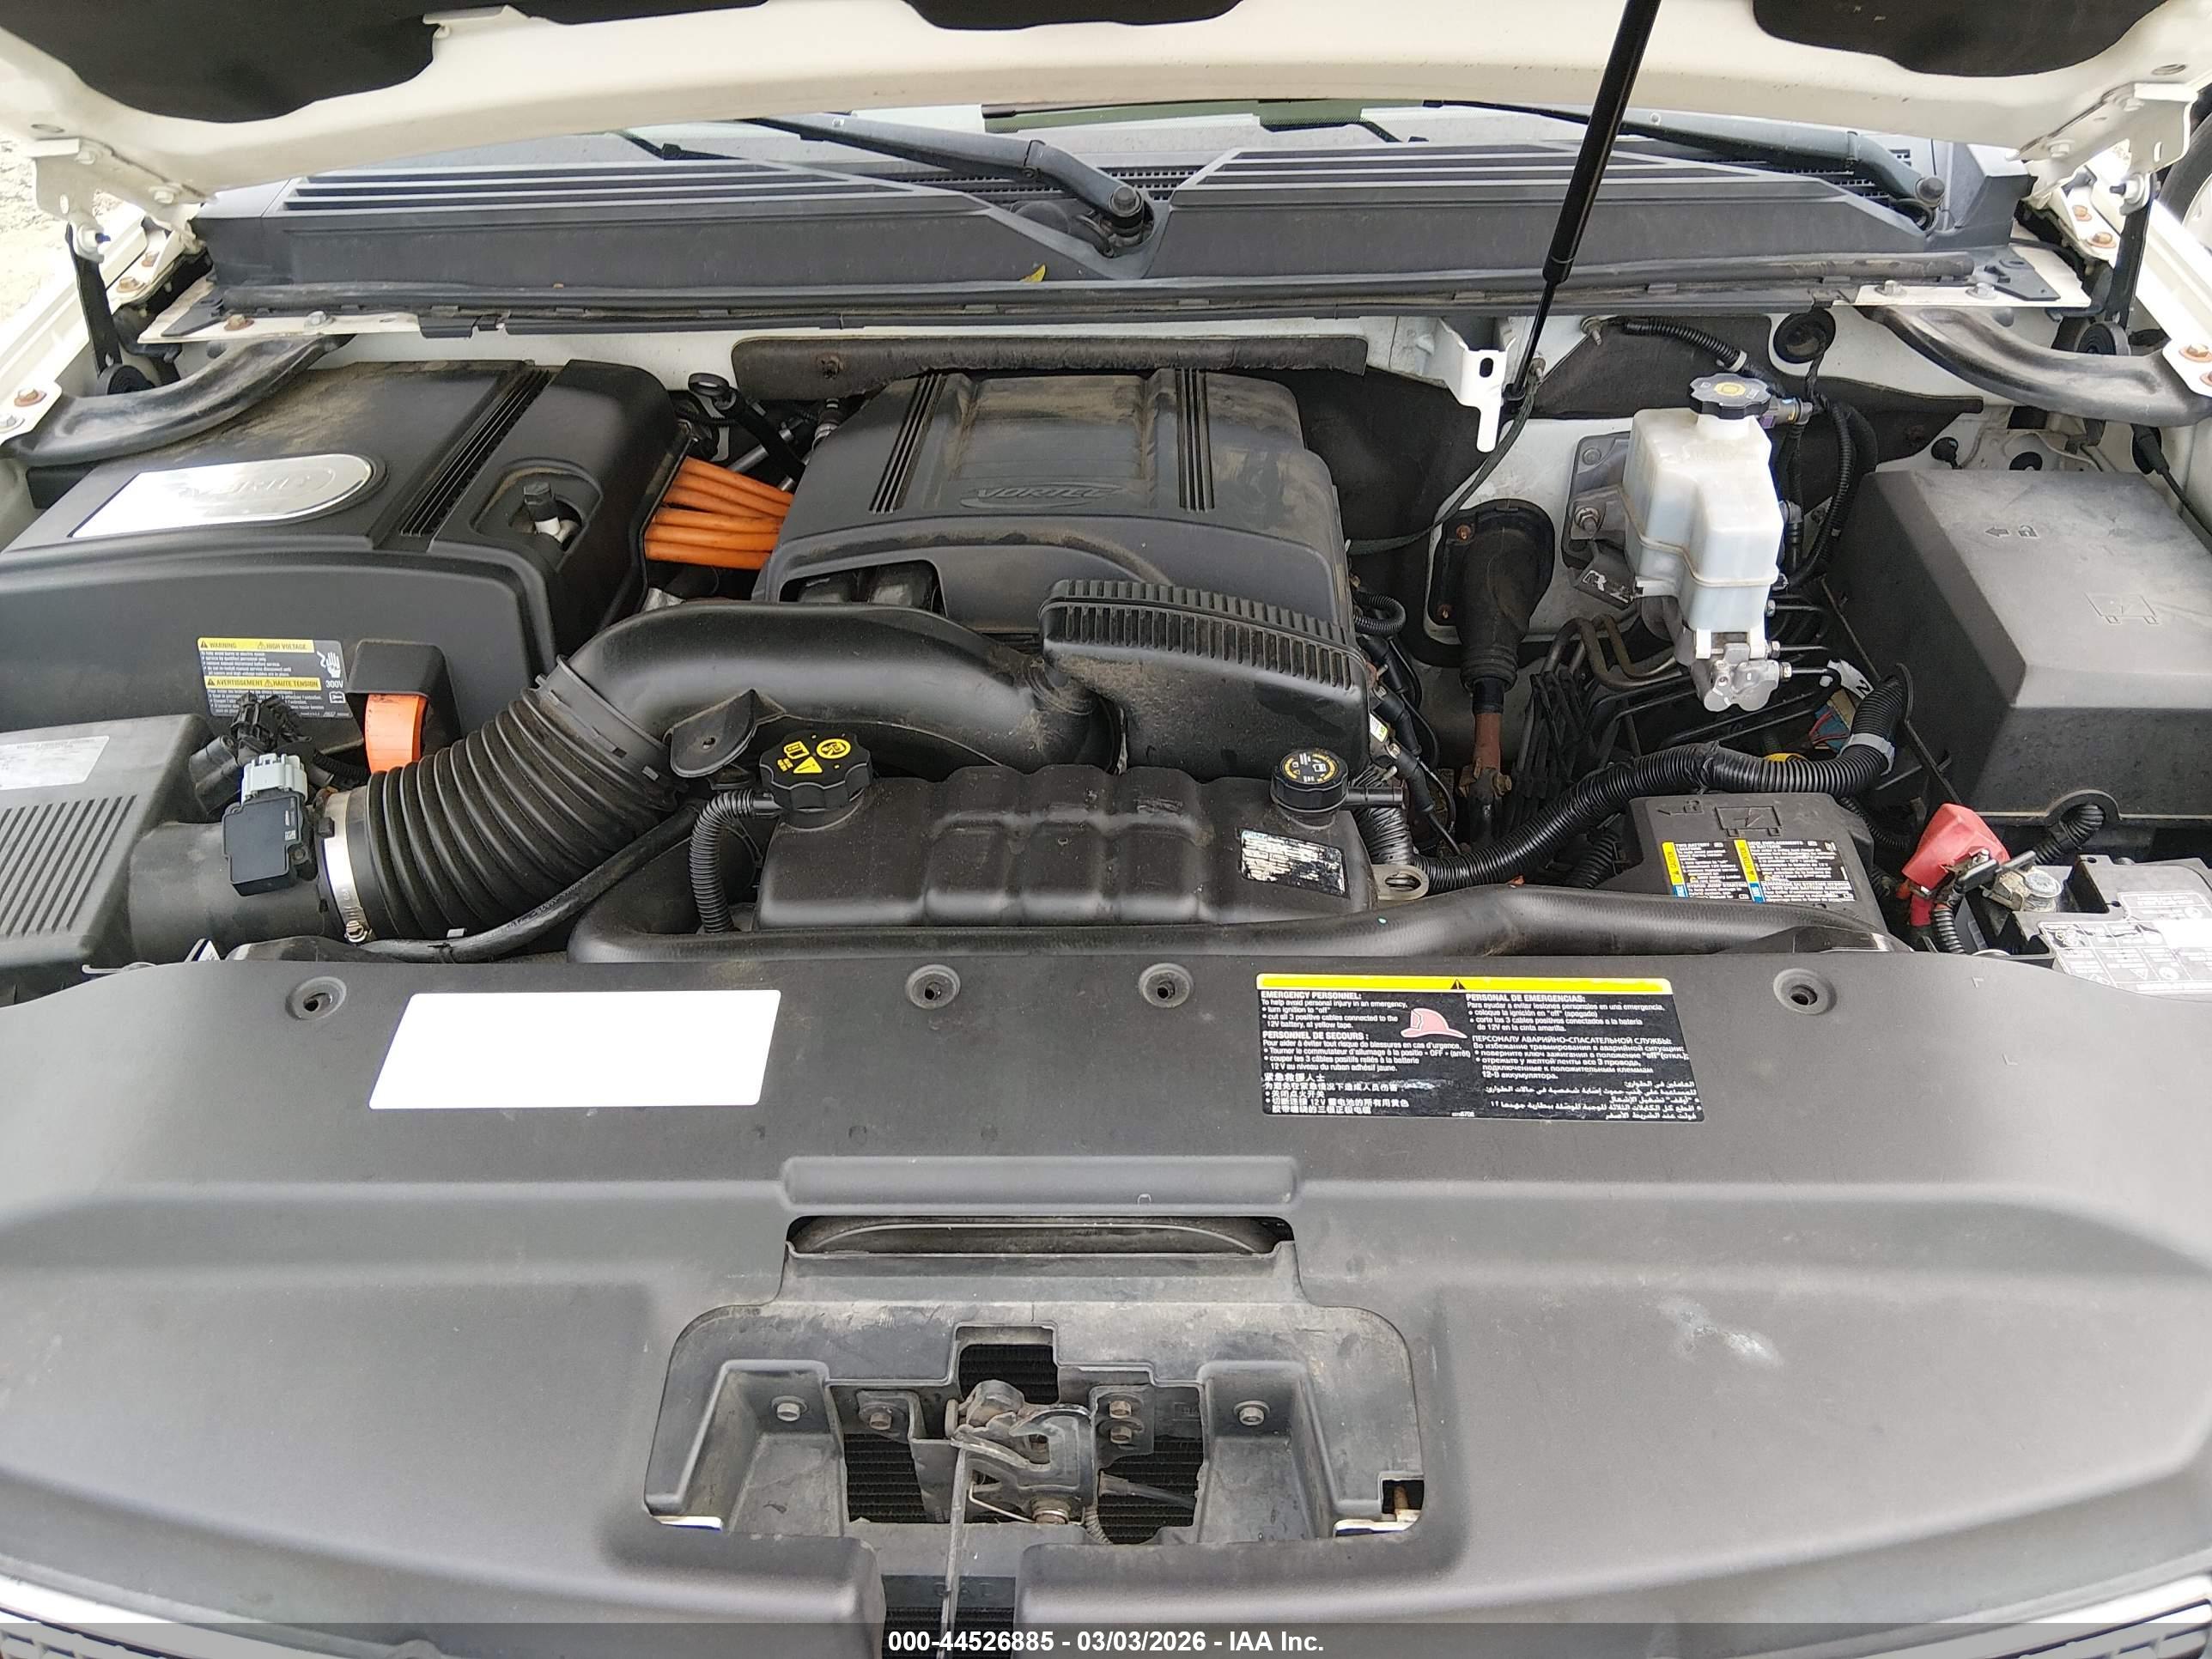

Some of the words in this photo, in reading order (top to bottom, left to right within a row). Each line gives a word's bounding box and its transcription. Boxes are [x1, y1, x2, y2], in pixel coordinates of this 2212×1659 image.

[977, 487, 1106, 499] VORTEC
[325, 680, 343, 689] 300V
[1522, 1036, 1633, 1044] АВАРИЙНО-СПАСАТЕЛЬНОЙ
